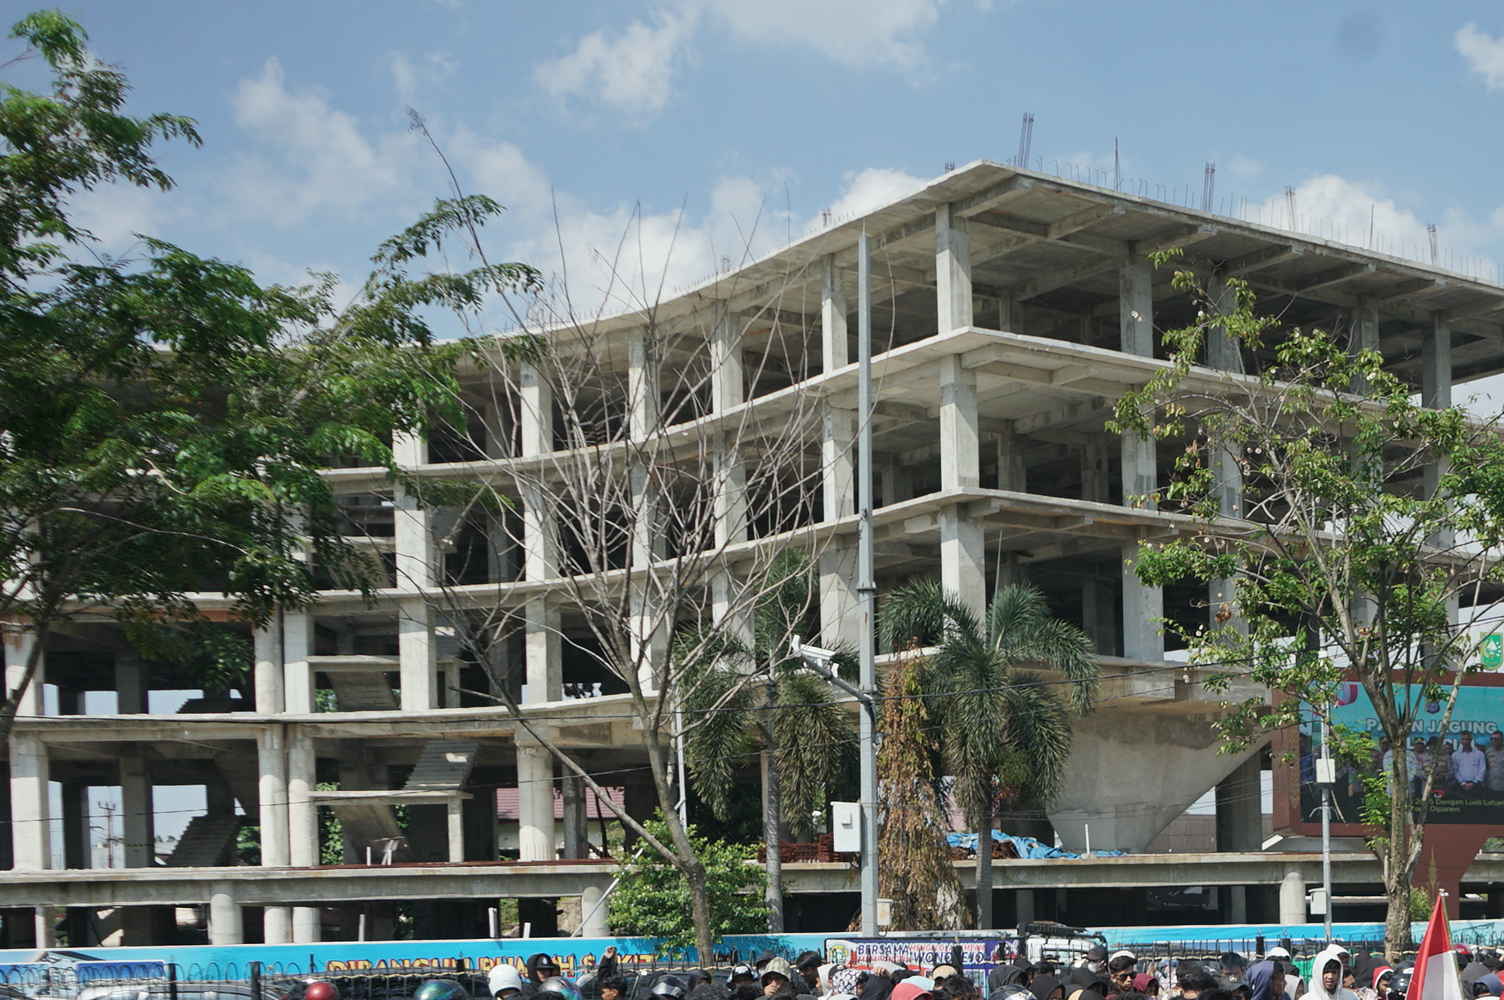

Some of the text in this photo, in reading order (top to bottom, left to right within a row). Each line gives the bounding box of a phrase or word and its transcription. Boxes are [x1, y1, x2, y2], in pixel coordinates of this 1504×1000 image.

[858, 944, 909, 955] BERSAMA
[581, 952, 659, 969] SKIT
[913, 951, 985, 963] WONOEJO
